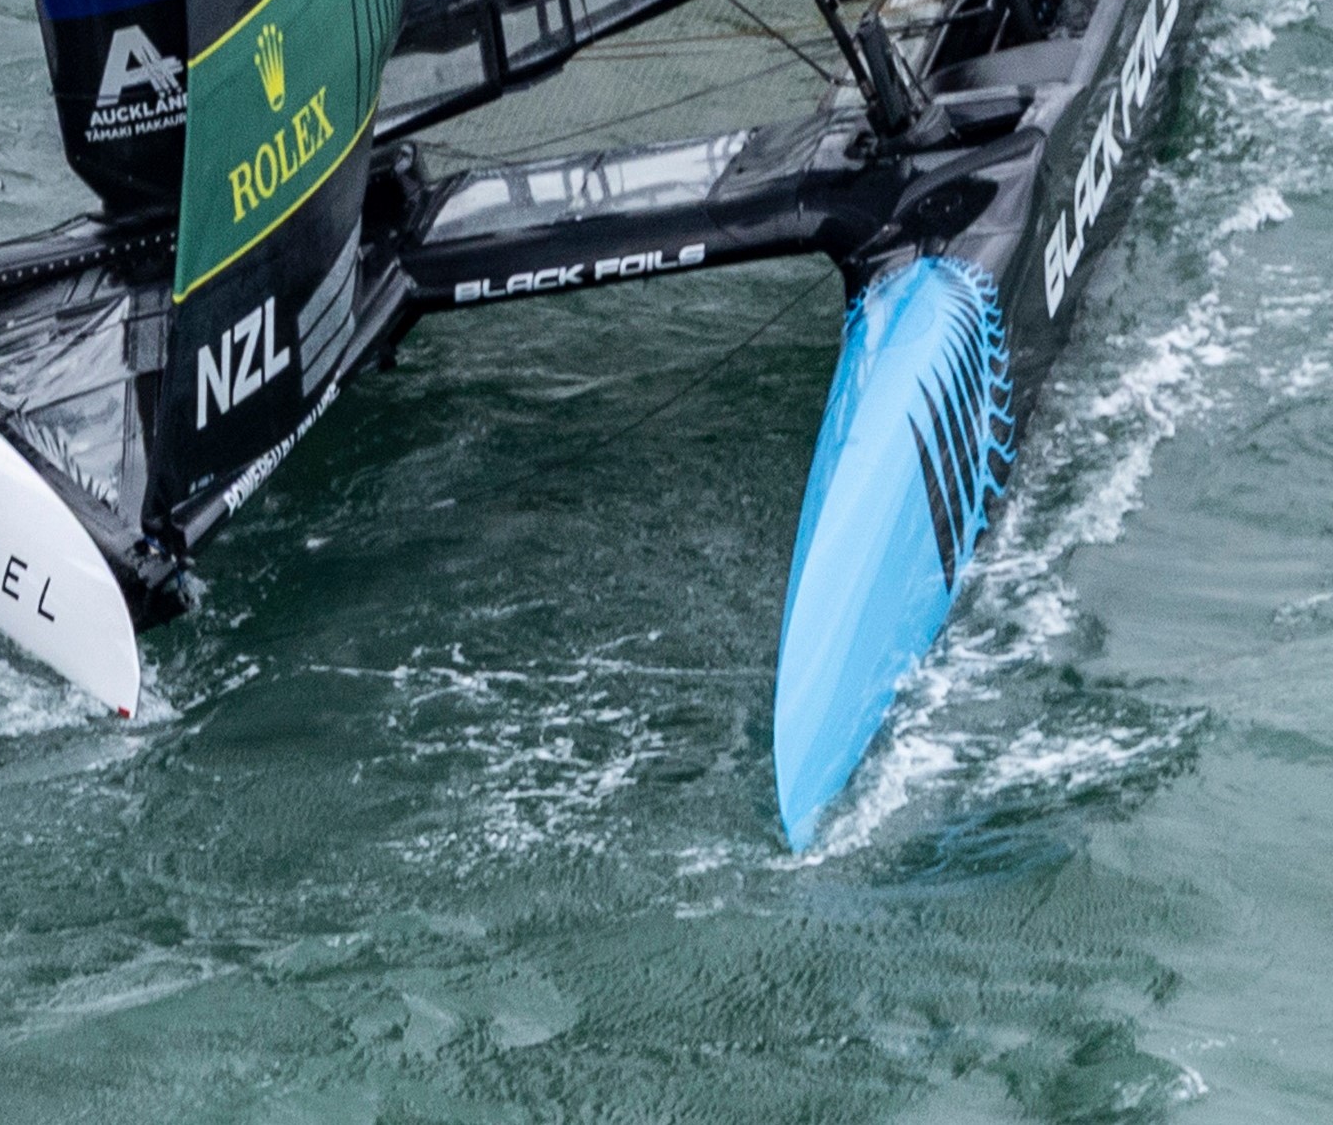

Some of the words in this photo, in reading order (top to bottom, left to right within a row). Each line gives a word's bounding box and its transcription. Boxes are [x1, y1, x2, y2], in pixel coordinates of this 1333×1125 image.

[229, 85, 334, 224] ROLEX
[1045, 88, 1123, 319] BLACK
[455, 263, 585, 303] BLACK
[595, 242, 706, 281] FOILS
[196, 295, 291, 431] NZL
